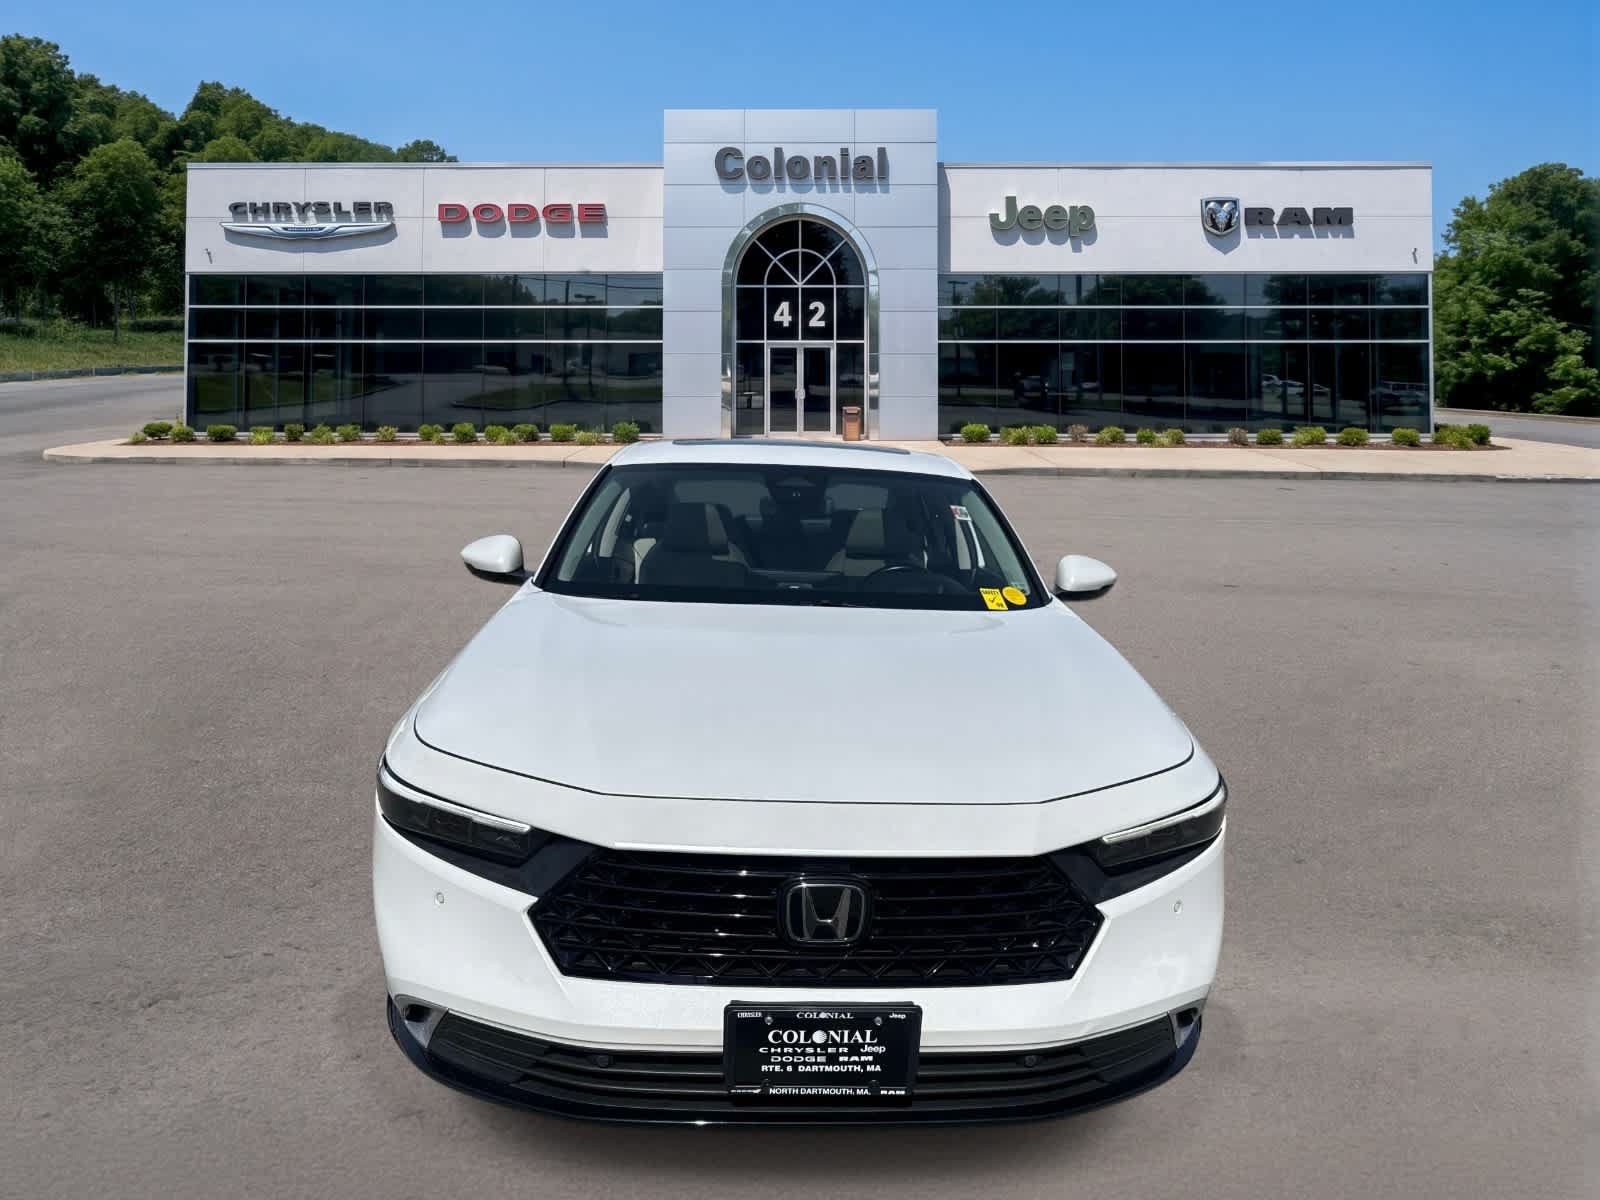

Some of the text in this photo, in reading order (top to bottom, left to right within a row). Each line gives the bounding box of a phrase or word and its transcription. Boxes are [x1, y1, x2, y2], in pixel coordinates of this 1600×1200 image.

[714, 146, 889, 180] Colonial
[228, 201, 394, 216] CHRYSLER
[437, 203, 606, 223] DODGE
[989, 195, 1096, 237] Jeep
[1244, 207, 1354, 226] RAM
[860, 1044, 886, 1054] Jeep
[798, 1065, 864, 1073] DARTMOUTH,
